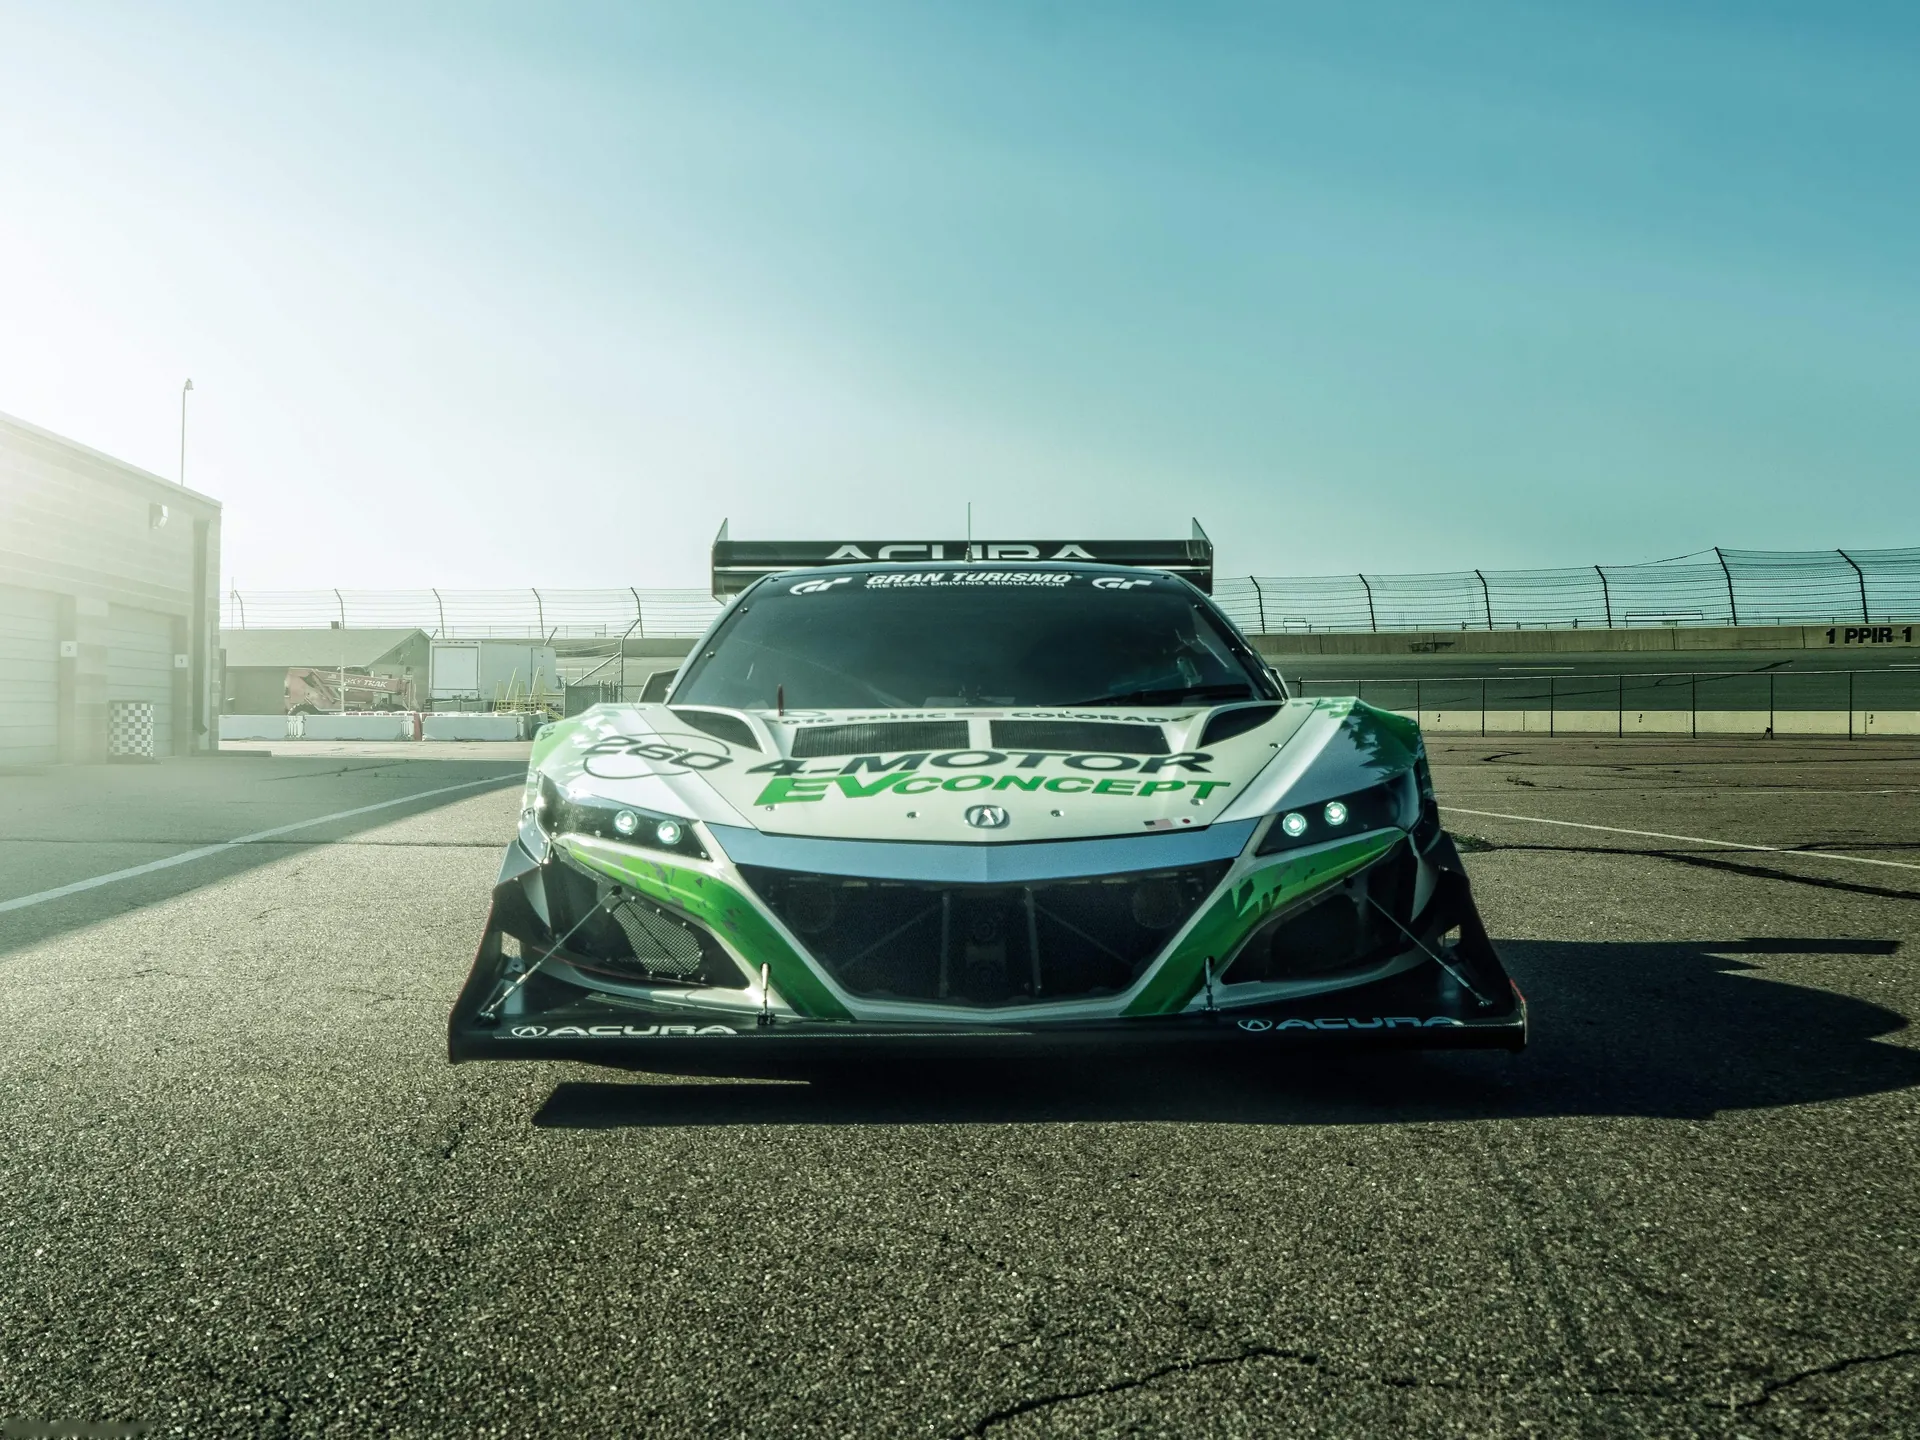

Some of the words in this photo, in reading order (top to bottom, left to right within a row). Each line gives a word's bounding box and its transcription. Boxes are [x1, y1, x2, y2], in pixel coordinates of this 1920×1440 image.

[866, 572, 946, 585] GRAN
[952, 571, 1073, 583] TURISMO
[1826, 628, 1836, 644] 1
[1844, 627, 1893, 644] PPIR
[1902, 627, 1912, 643] 1
[364, 679, 388, 688] TRAK
[1011, 711, 1195, 723] COLORADO
[581, 735, 734, 770] 260
[744, 750, 1214, 777] 4-MOTOR
[1275, 1016, 1465, 1030] ACURA
[547, 1025, 738, 1036] ACURA
